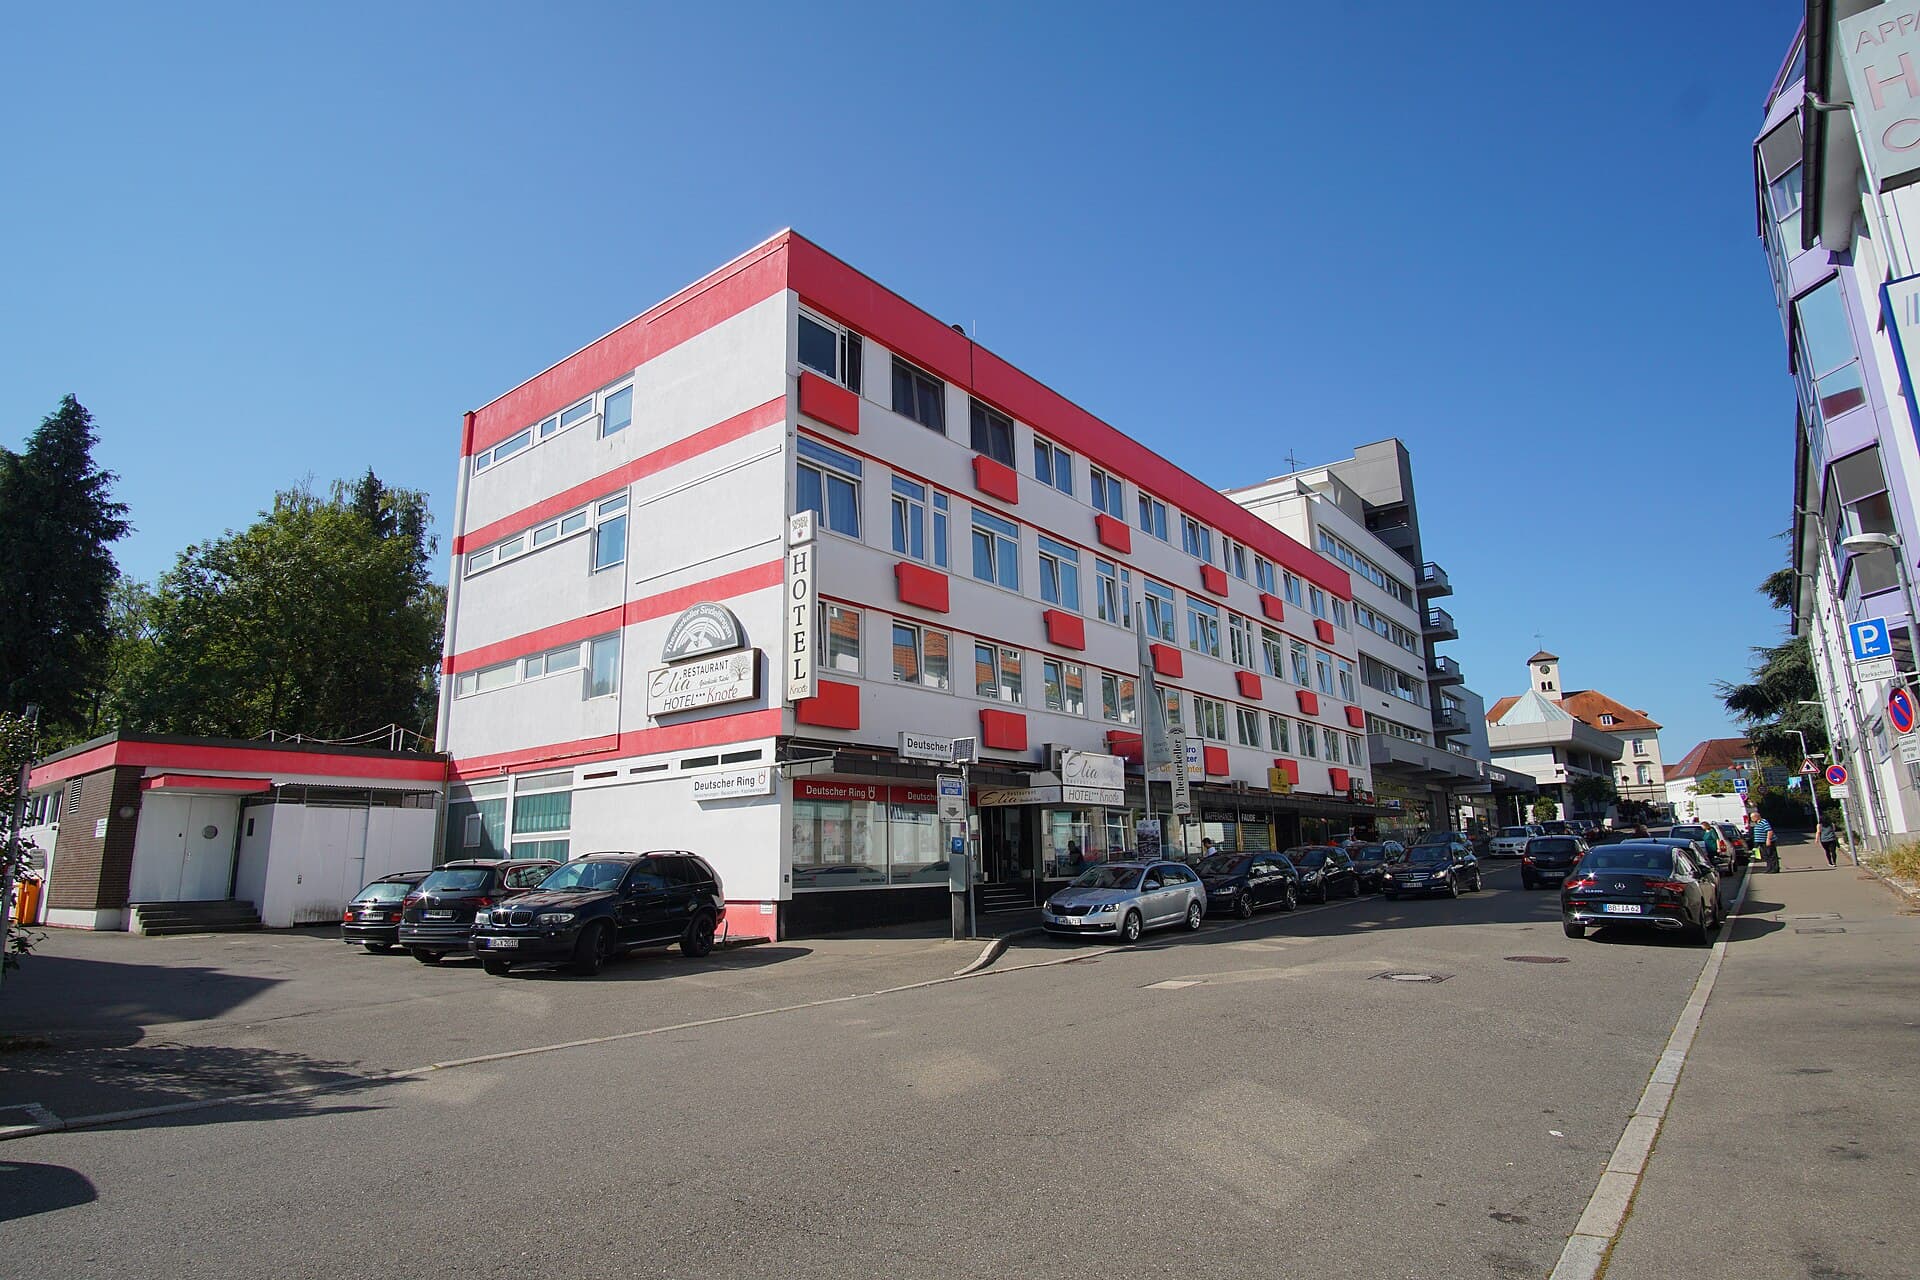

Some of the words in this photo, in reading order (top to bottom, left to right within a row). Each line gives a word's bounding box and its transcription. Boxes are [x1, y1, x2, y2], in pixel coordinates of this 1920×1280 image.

[792, 551, 807, 681] HOTEL
[666, 607, 700, 654] Theaterkeller
[1857, 625, 1879, 655] P
[683, 659, 729, 678] RESTAURANT
[651, 669, 691, 698] Elia
[663, 694, 696, 711] HOTEL
[707, 683, 738, 703] Knote
[907, 737, 947, 752] Deutscher
[1065, 751, 1098, 779] Elia
[1173, 739, 1185, 797] Theaterkeller
[694, 778, 736, 791] Deutscher
[736, 775, 755, 788] Ring
[806, 785, 846, 797] Deutscher
[848, 787, 866, 799] Ring
[1068, 789, 1093, 801] HOTEL
[980, 791, 1017, 806] Elia
